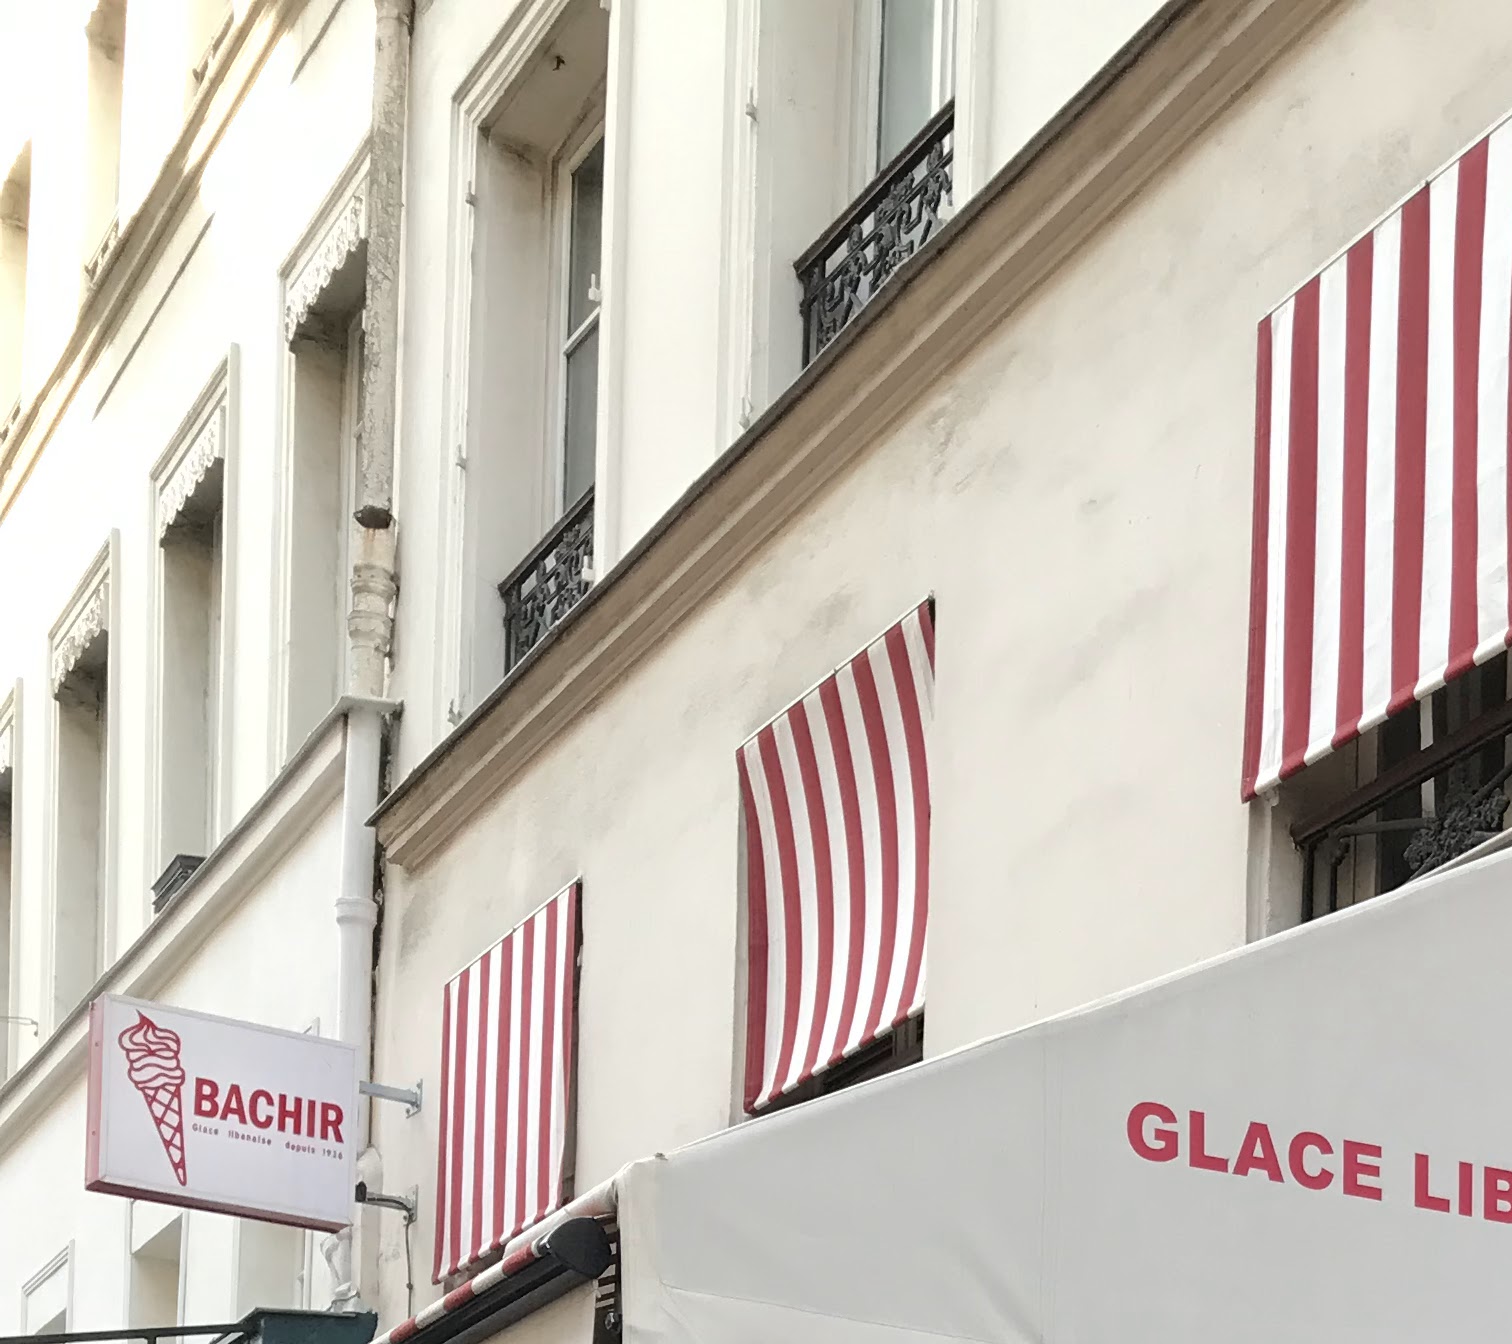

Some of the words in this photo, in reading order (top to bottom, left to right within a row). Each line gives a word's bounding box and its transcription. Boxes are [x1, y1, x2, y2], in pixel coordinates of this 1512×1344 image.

[192, 1123, 219, 1135] Glace
[228, 1130, 272, 1146] libanaise
[285, 1141, 316, 1155] depuis
[322, 1148, 343, 1160] 1936
[194, 1077, 344, 1144] BACHIR
[1126, 1101, 1383, 1201] GLACE
